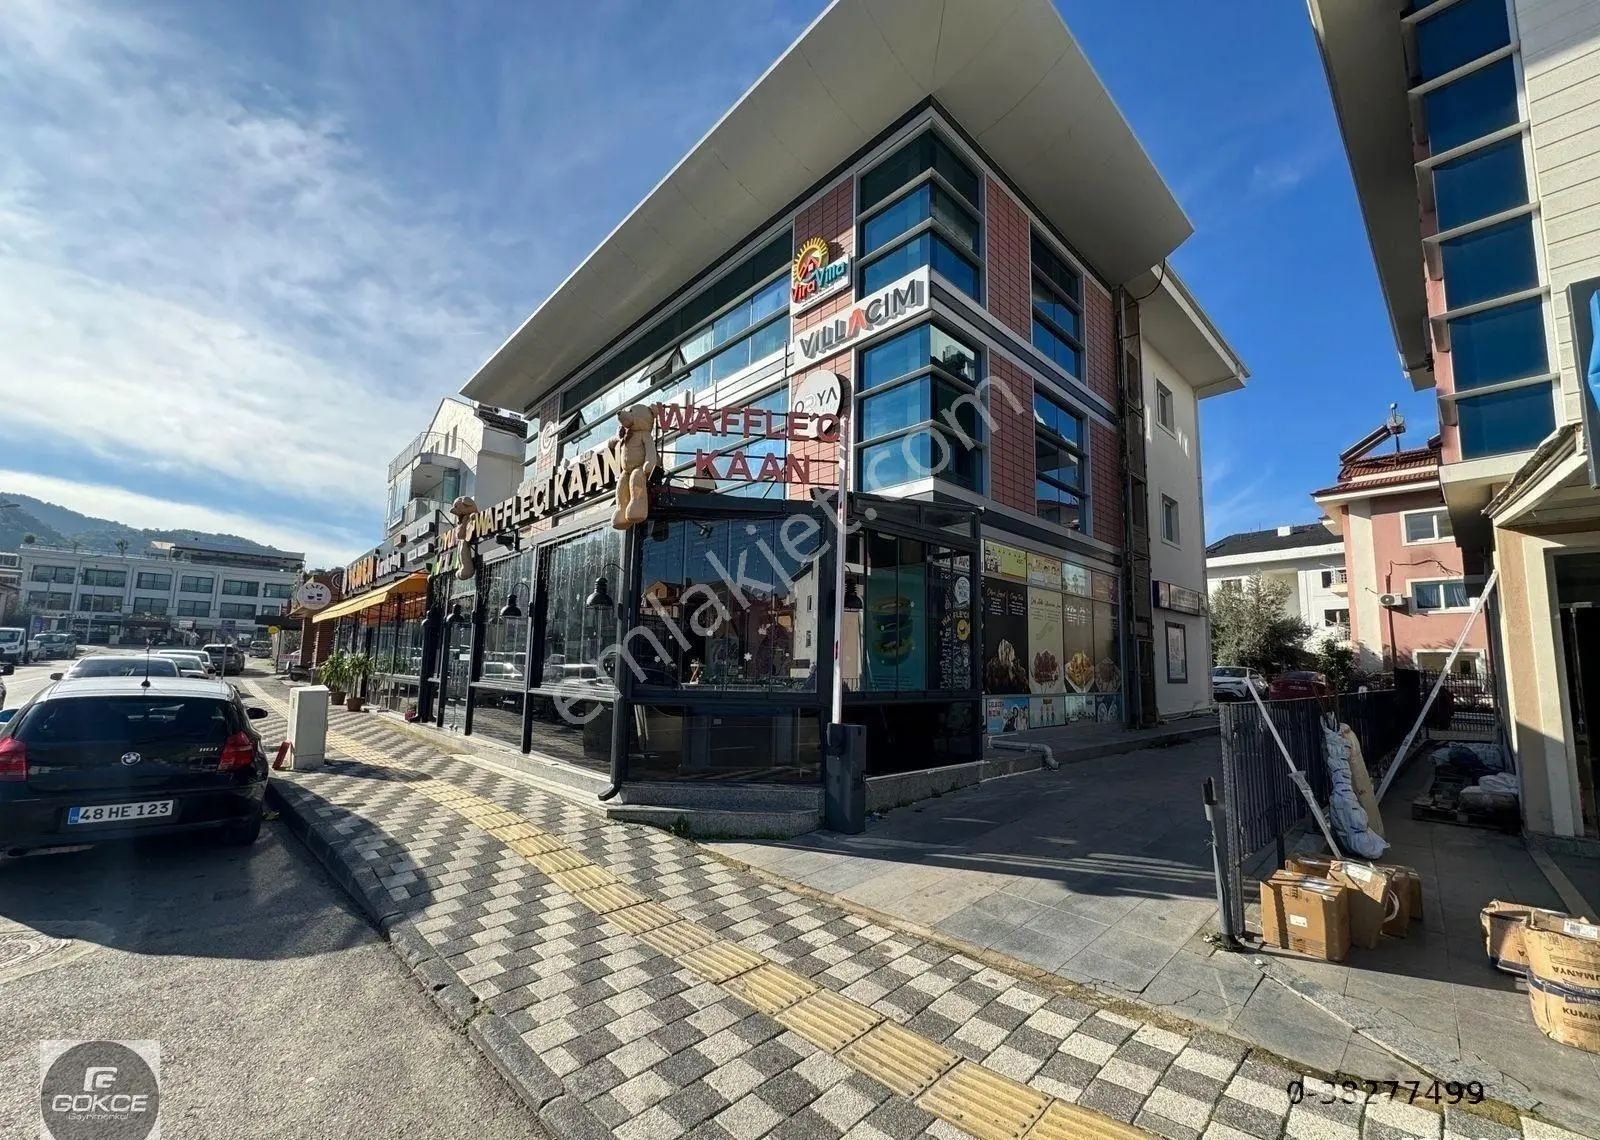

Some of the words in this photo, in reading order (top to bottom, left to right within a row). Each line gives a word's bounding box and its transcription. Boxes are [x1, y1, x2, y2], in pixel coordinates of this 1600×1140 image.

[814, 261, 847, 286] Villa
[554, 447, 623, 507] KAAN
[696, 448, 810, 484] KAAN
[80, 807, 104, 821] 48
[108, 805, 132, 819] HE
[136, 802, 169, 817] 123
